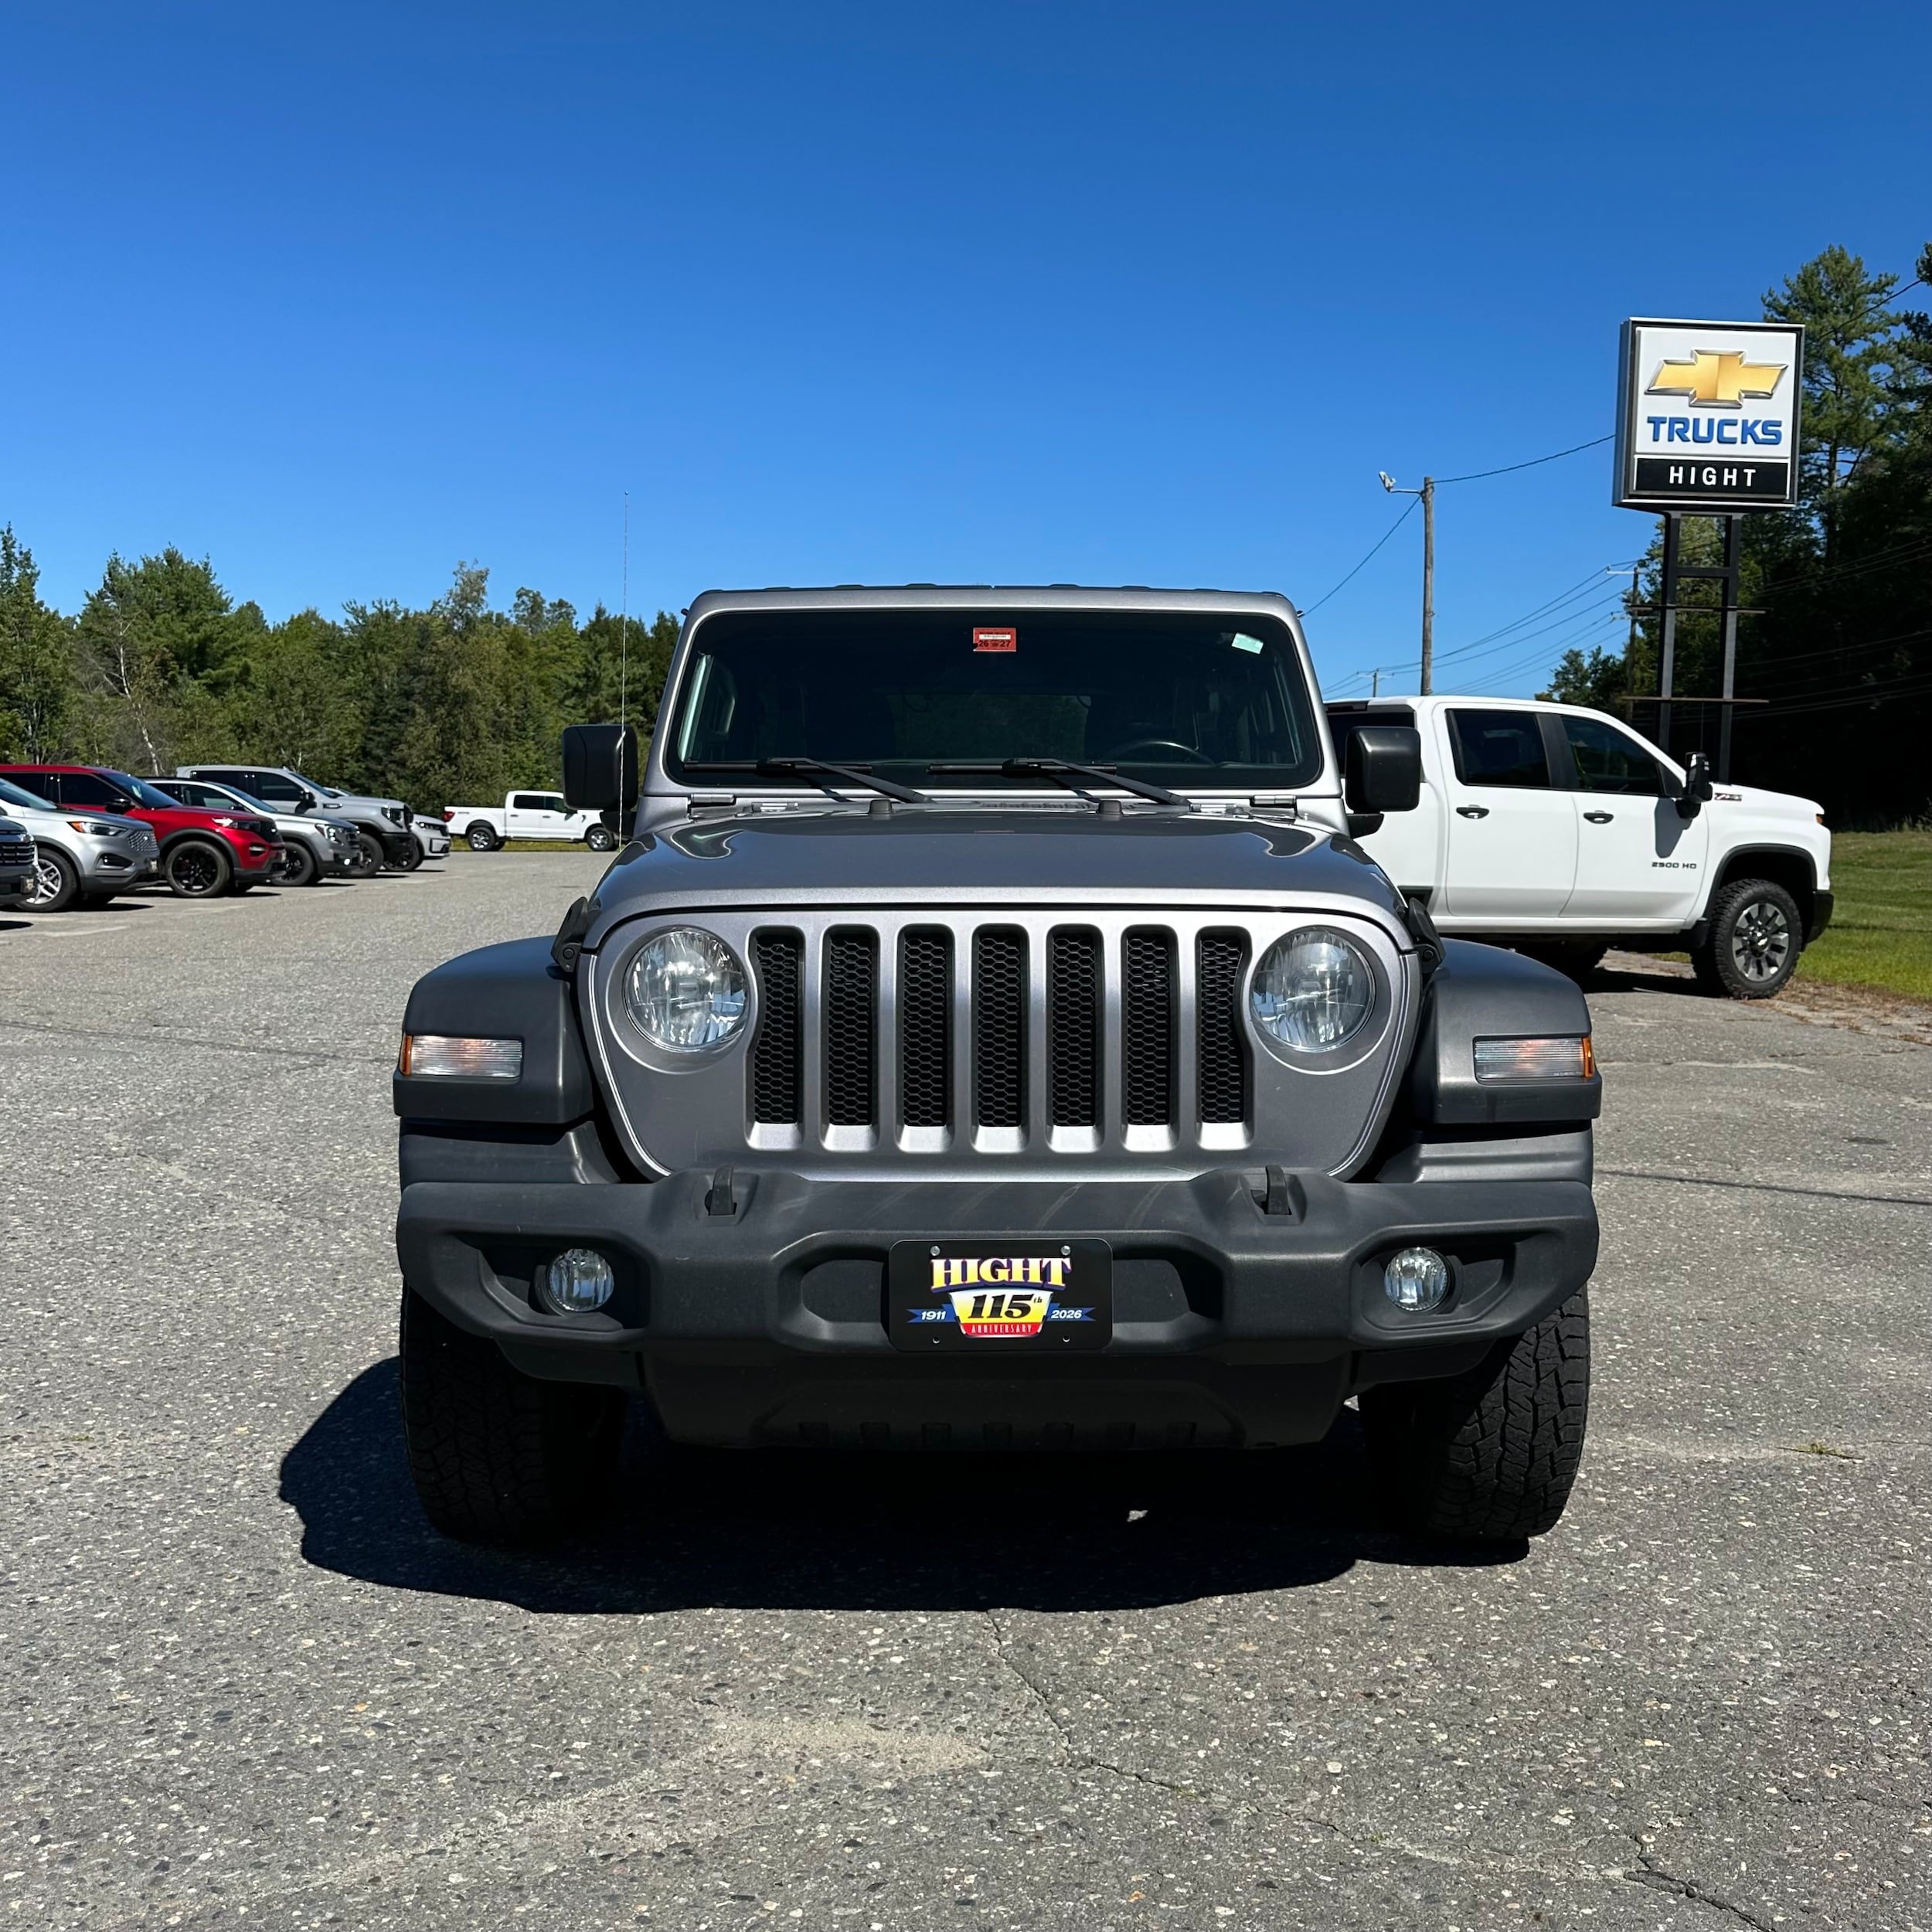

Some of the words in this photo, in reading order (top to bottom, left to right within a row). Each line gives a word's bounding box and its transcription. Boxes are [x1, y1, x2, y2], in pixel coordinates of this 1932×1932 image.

[1647, 417, 1782, 444] TRUCKS
[1669, 466, 1757, 487] HIGHT
[930, 1257, 1072, 1292] HIGHT
[921, 1311, 946, 1320] 1911
[1051, 1310, 1083, 1319] 2026
[971, 1324, 1032, 1333] ANNIVERSARY
